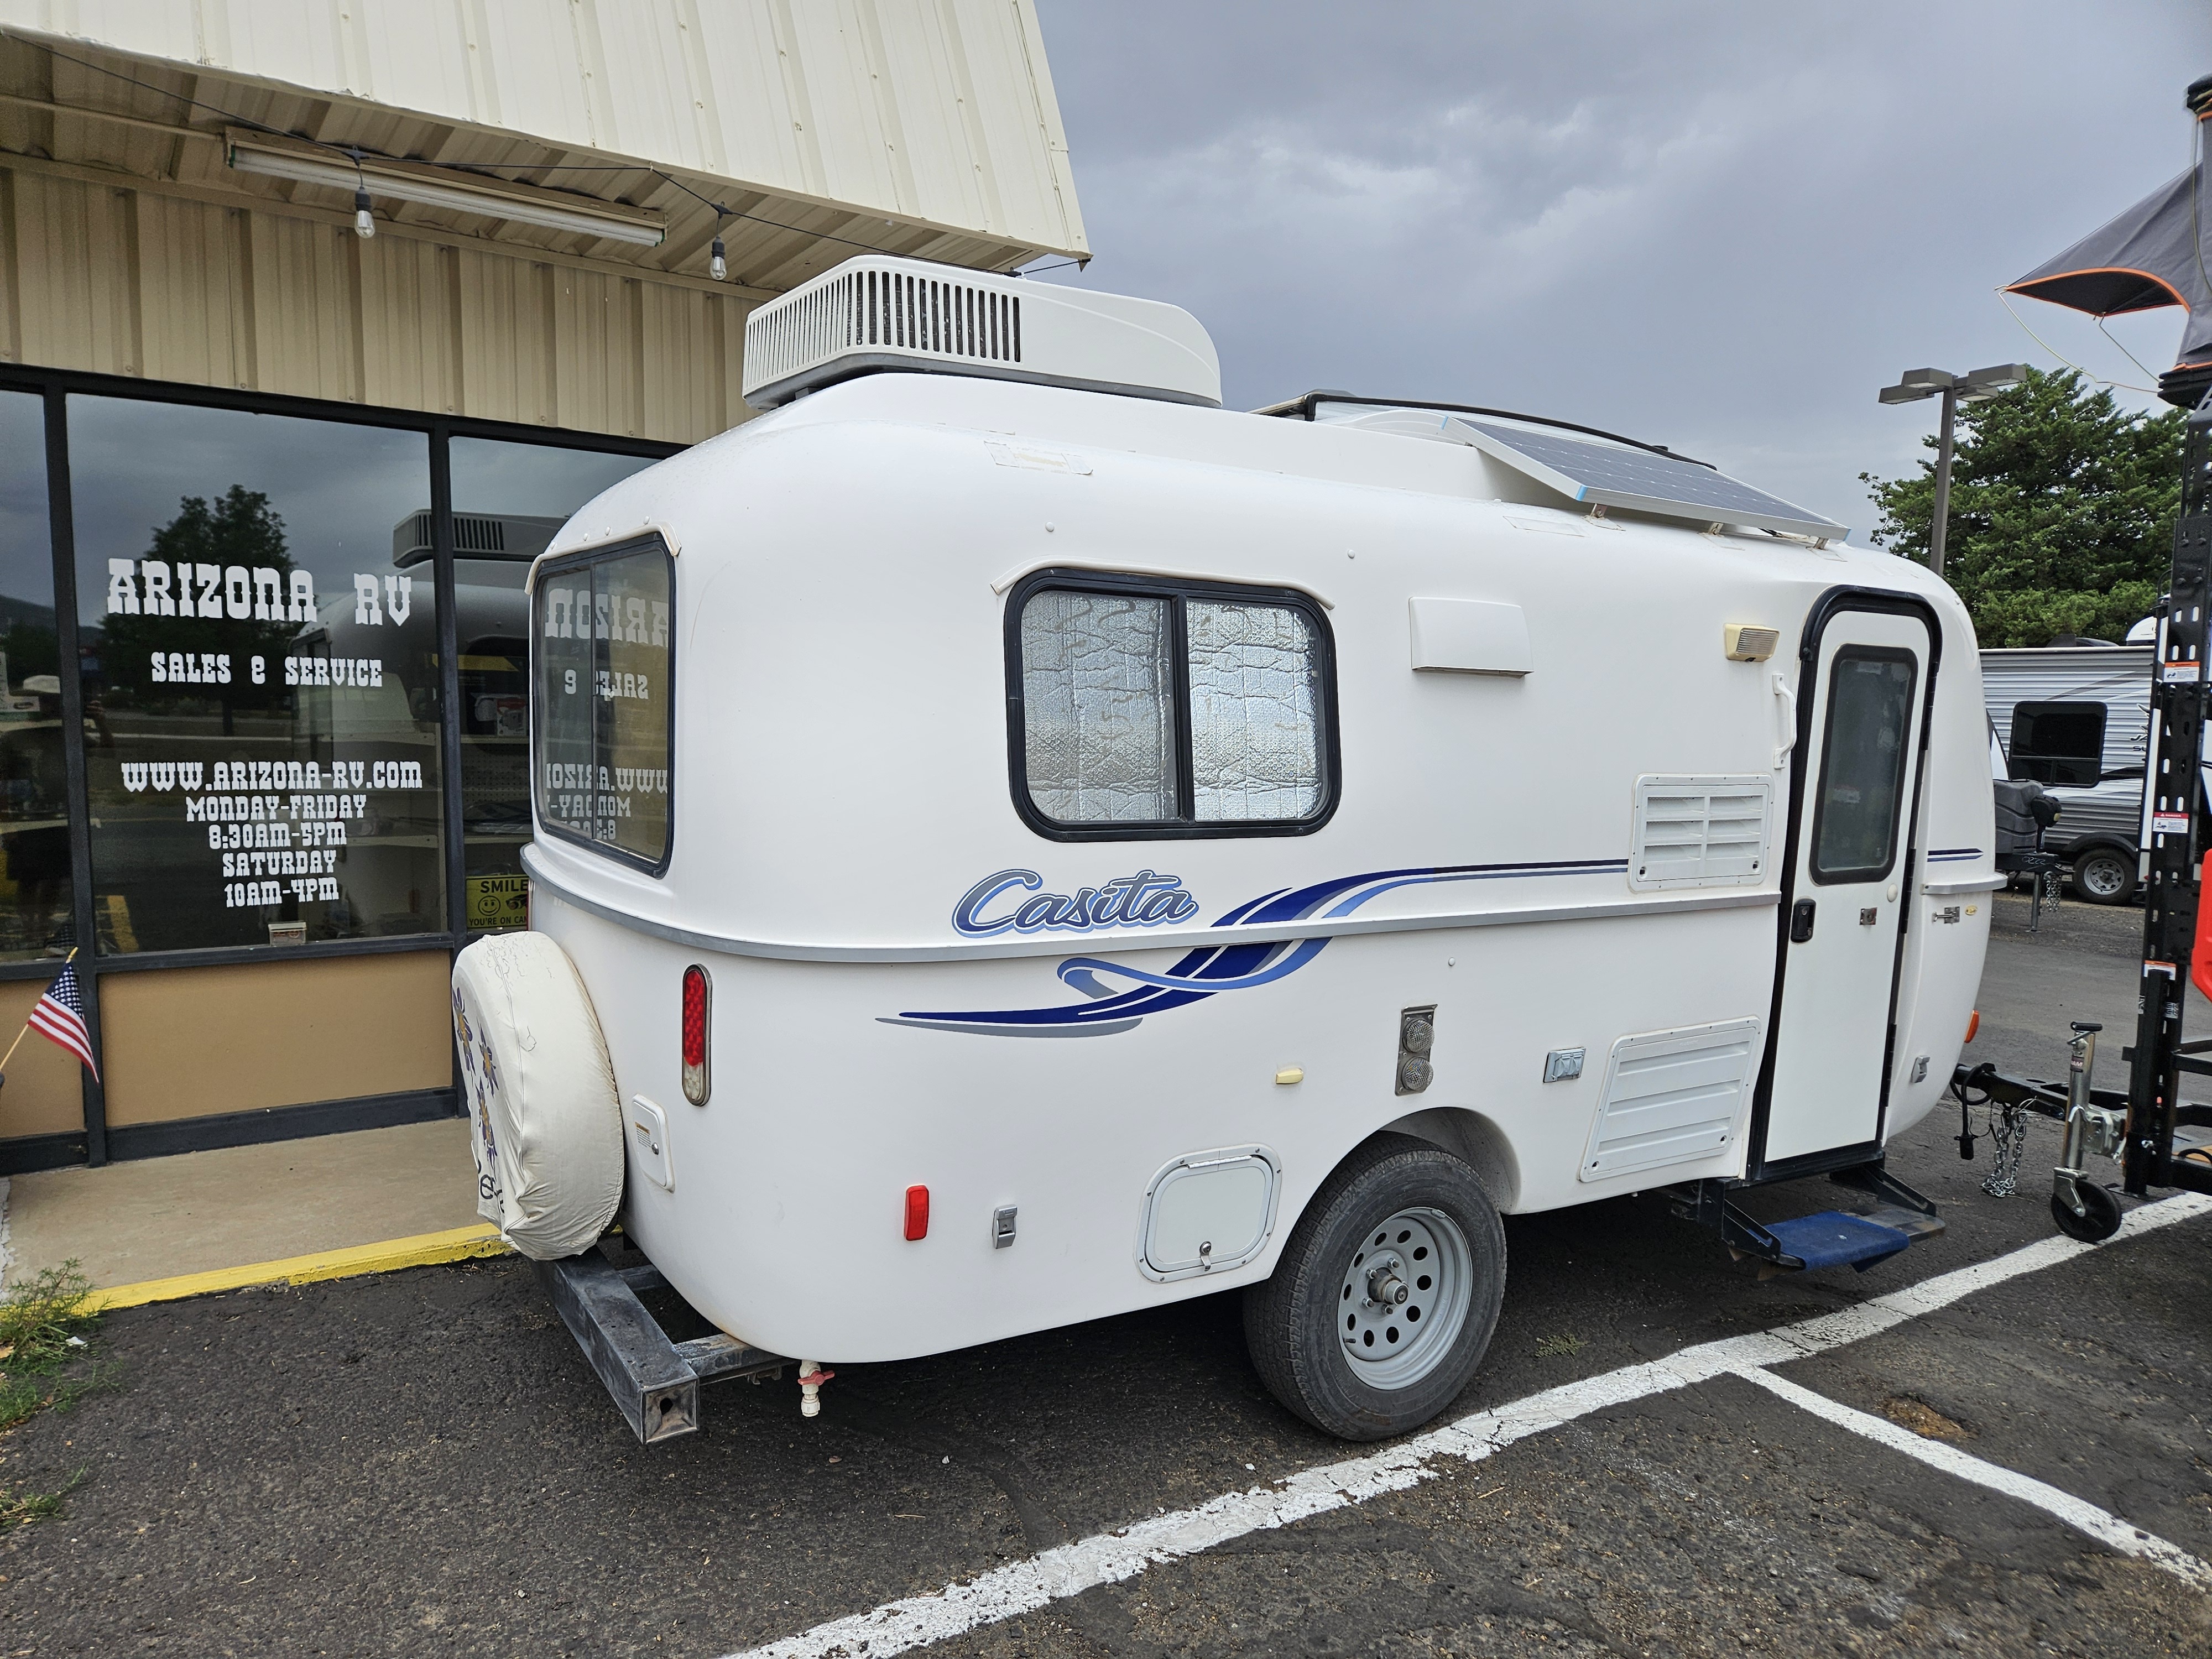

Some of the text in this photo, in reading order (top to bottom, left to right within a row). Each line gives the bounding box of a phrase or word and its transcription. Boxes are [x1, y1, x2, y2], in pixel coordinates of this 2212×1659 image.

[108, 558, 412, 627] ARIZONA RV
[151, 651, 231, 684] SALES
[285, 656, 383, 687] SERVICE
[121, 761, 423, 792] WWW.ARIZONA-RV.COM
[186, 794, 367, 822] MONDAY-FRIDAY
[208, 821, 347, 850] 8:30AM-5PM
[222, 849, 337, 878] SATURDAY
[224, 877, 339, 908] 10AM-4PM
[480, 879, 529, 893] SMILE
[952, 869, 1199, 937] Casita
[469, 916, 497, 926] YOU'RE
